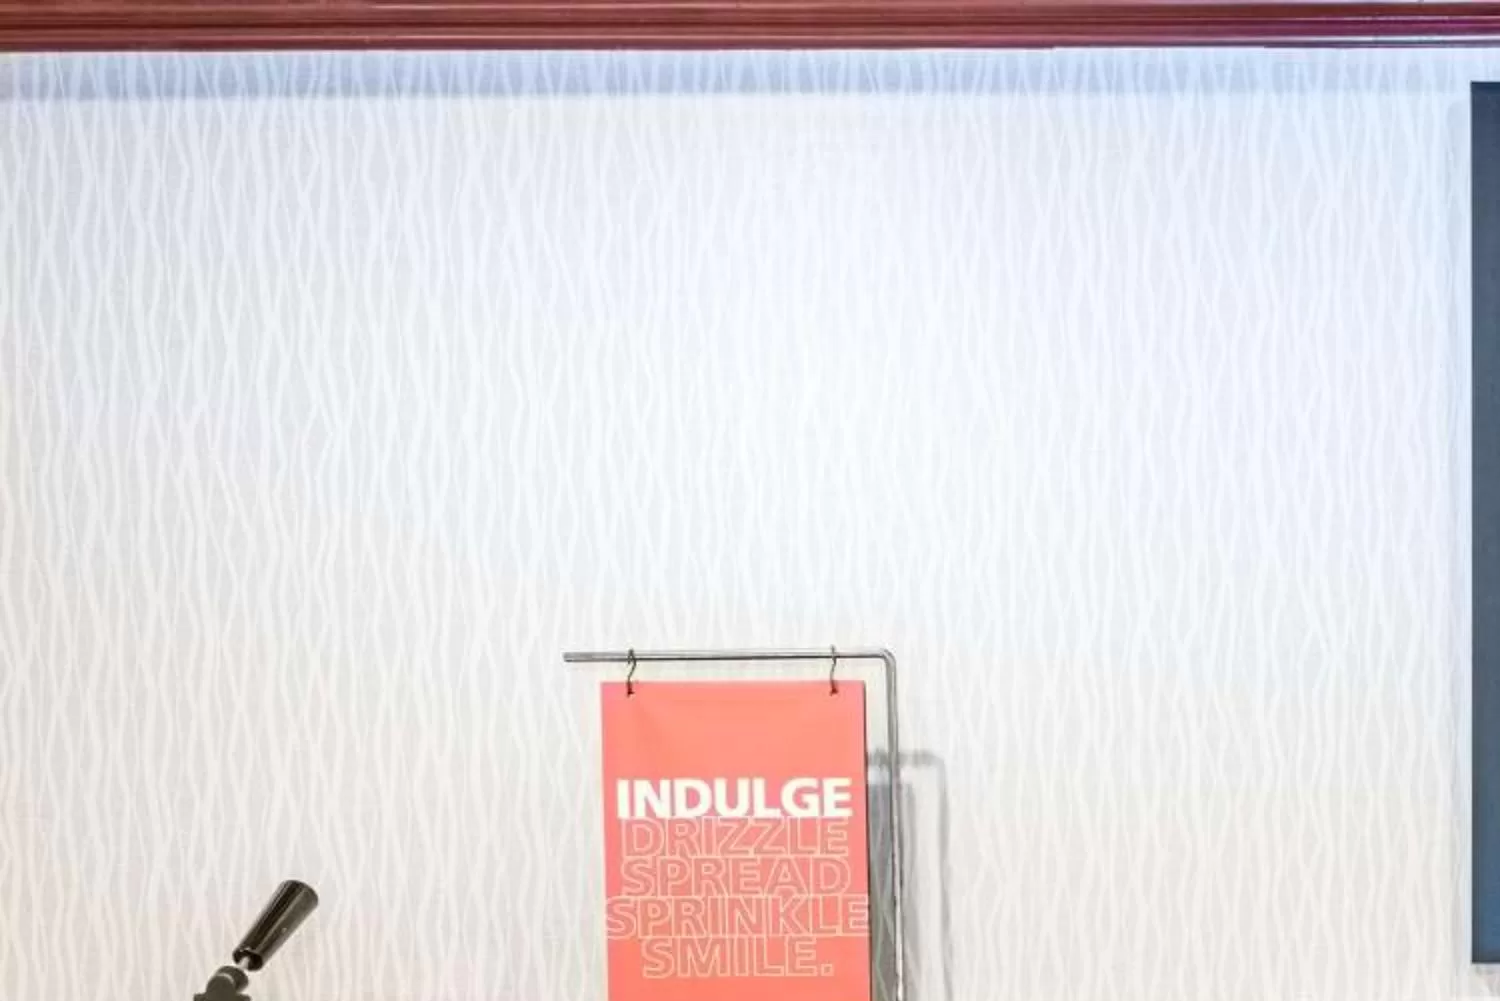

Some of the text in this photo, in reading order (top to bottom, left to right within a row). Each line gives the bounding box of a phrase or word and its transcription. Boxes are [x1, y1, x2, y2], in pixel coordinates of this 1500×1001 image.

[616, 777, 853, 819] INDULGE
[621, 815, 849, 858] DRIZZLE
[620, 855, 851, 898] SPREAD
[604, 894, 871, 938] SPRINKLE
[642, 934, 834, 978] SMILE.
